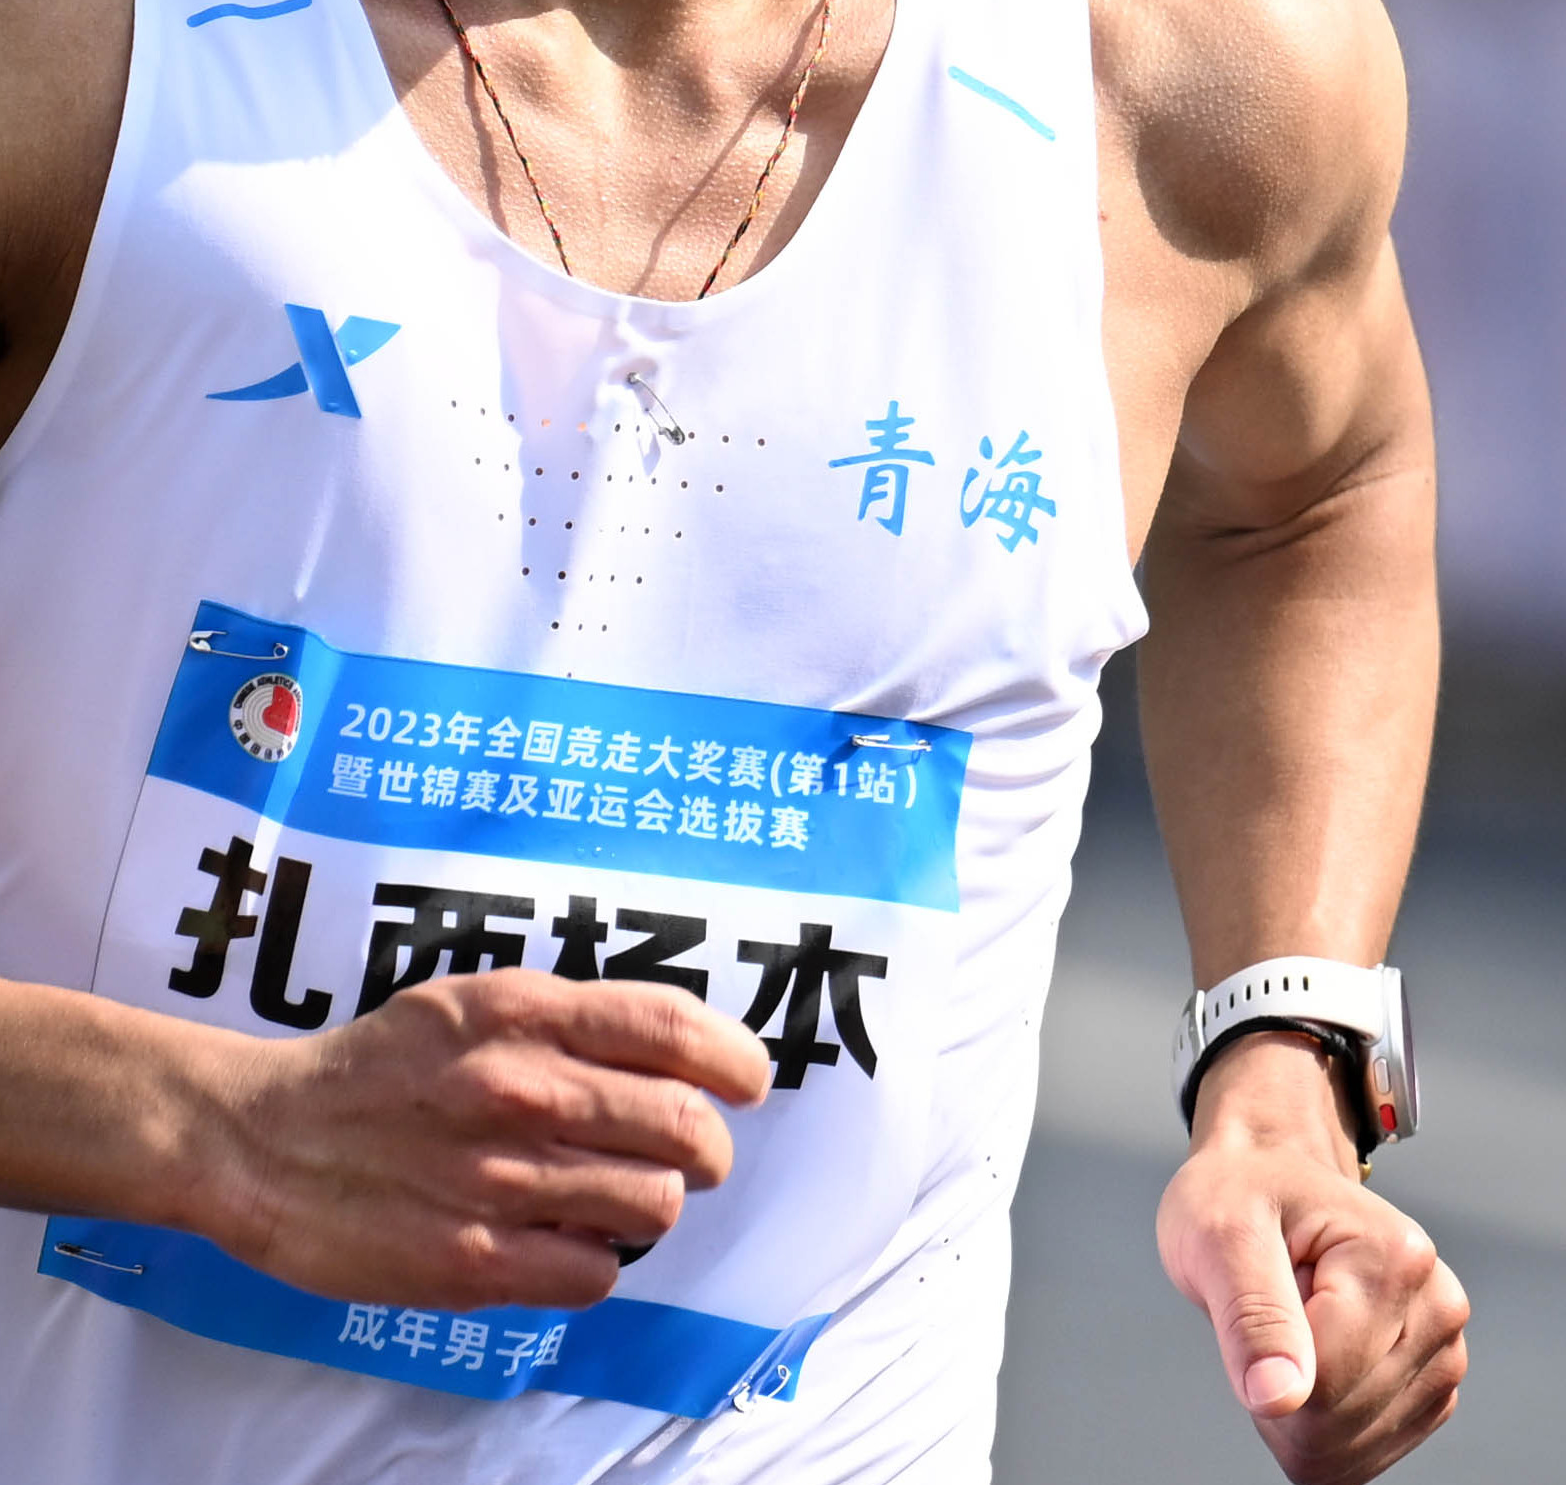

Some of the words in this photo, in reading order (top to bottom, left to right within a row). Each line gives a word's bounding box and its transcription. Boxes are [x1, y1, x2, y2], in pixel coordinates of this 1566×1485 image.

[828, 399, 1057, 553] 青海
[327, 752, 810, 852] 暨世锦赛及亚运会选拔赛
[338, 1302, 567, 1378] 成年男子组
